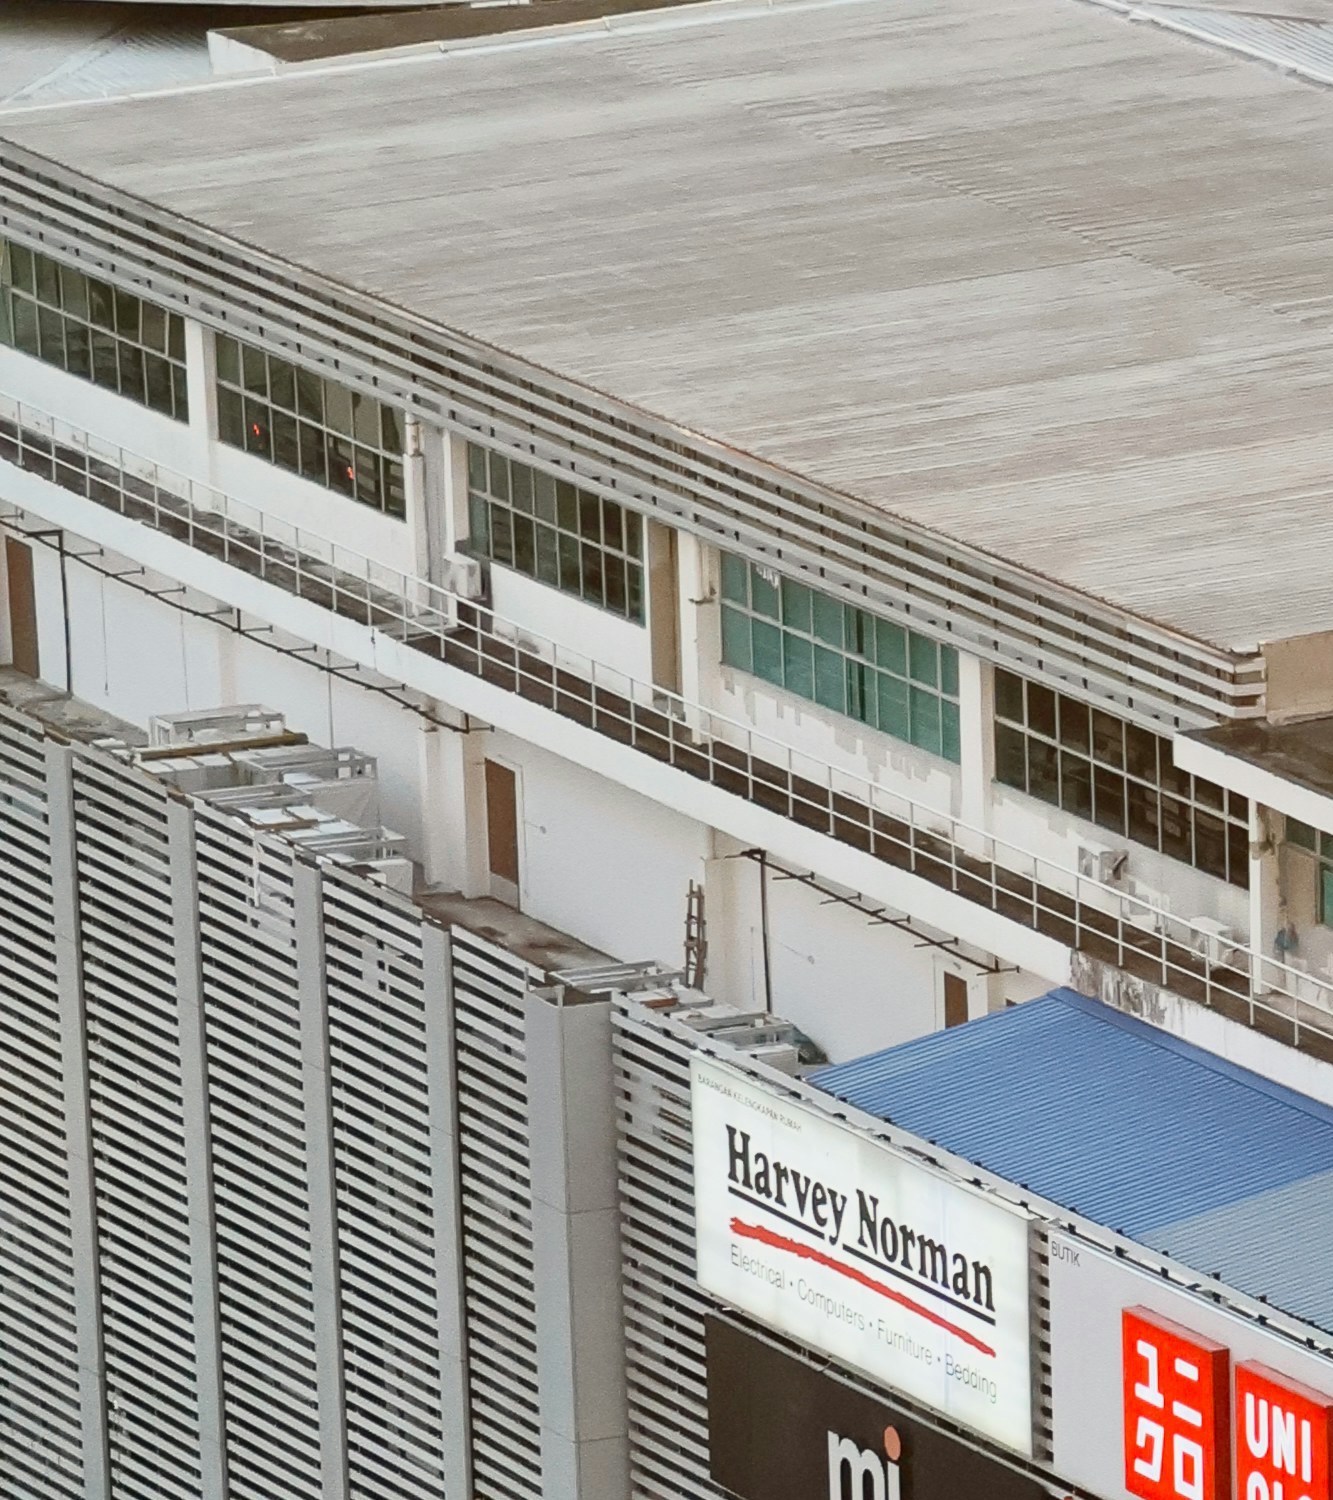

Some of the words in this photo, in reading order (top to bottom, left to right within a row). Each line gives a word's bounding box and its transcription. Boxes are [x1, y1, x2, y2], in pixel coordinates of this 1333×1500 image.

[725, 1124, 847, 1246] Harvey
[856, 1189, 996, 1312] Norman
[1051, 1239, 1081, 1268] BUTIK
[730, 1243, 785, 1290] Electrical
[797, 1278, 866, 1332] Computers
[877, 1318, 933, 1367] Furniture
[944, 1353, 998, 1405] Bedding
[1244, 1391, 1312, 1484] UNI
